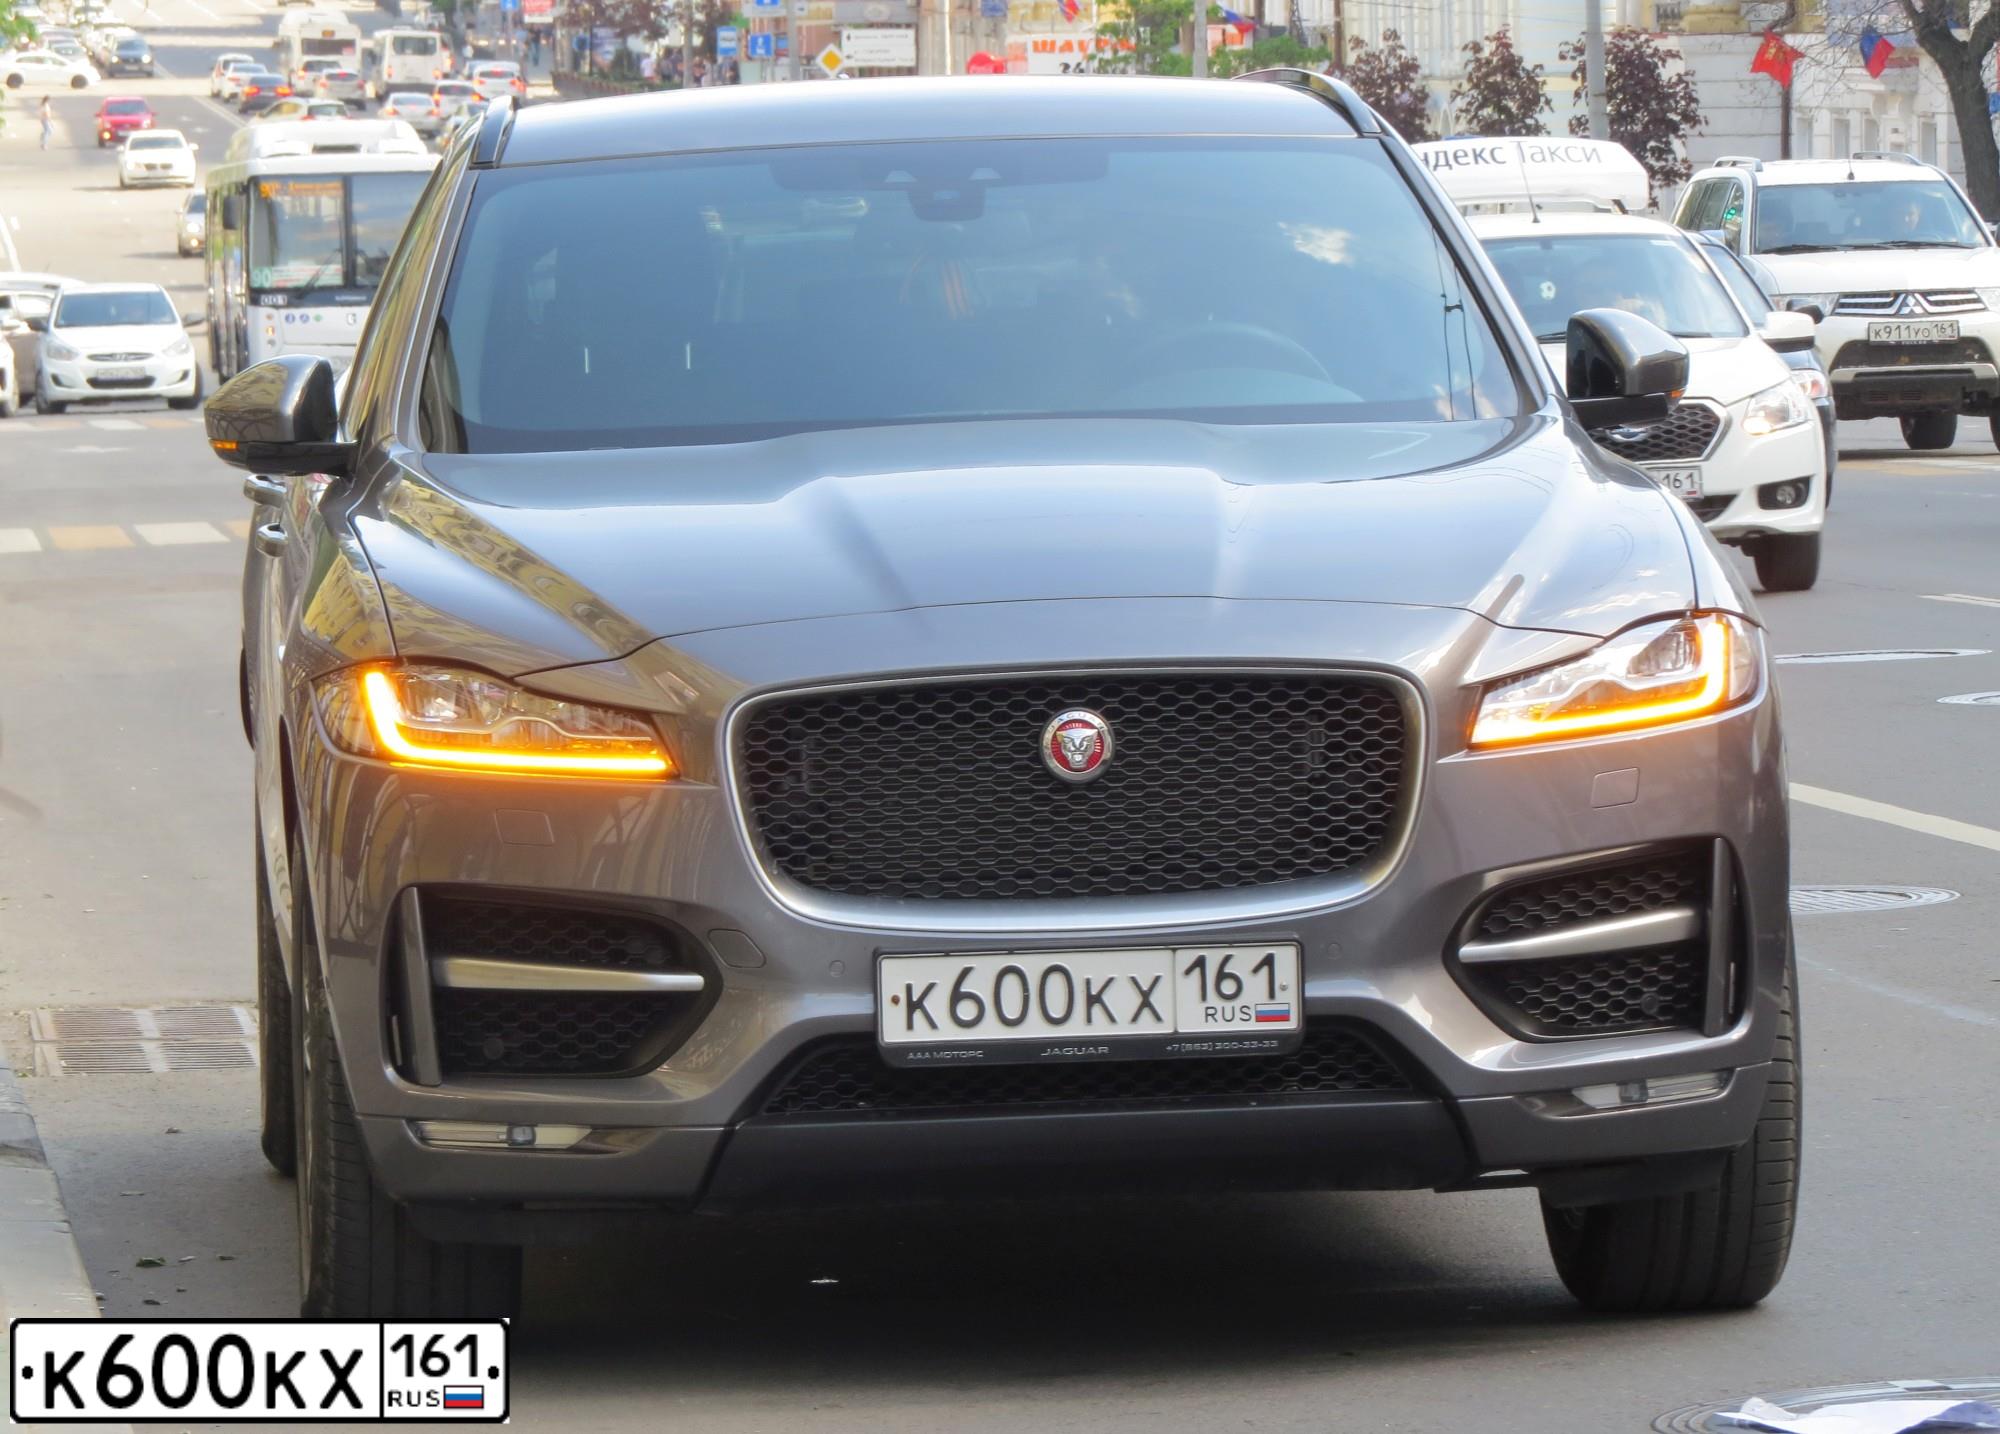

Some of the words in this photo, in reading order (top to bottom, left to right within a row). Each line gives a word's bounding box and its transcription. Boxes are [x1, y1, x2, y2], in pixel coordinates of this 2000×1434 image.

[1419, 146, 1507, 171] ндекс
[1510, 140, 1602, 164] Такси
[1933, 322, 1955, 335] 161
[1662, 472, 1694, 489] 161
[904, 962, 1164, 1031] К600КХ
[1183, 952, 1277, 1002] 161
[1204, 1003, 1252, 1023] RUS
[1040, 1045, 1110, 1056] JAGUAR
